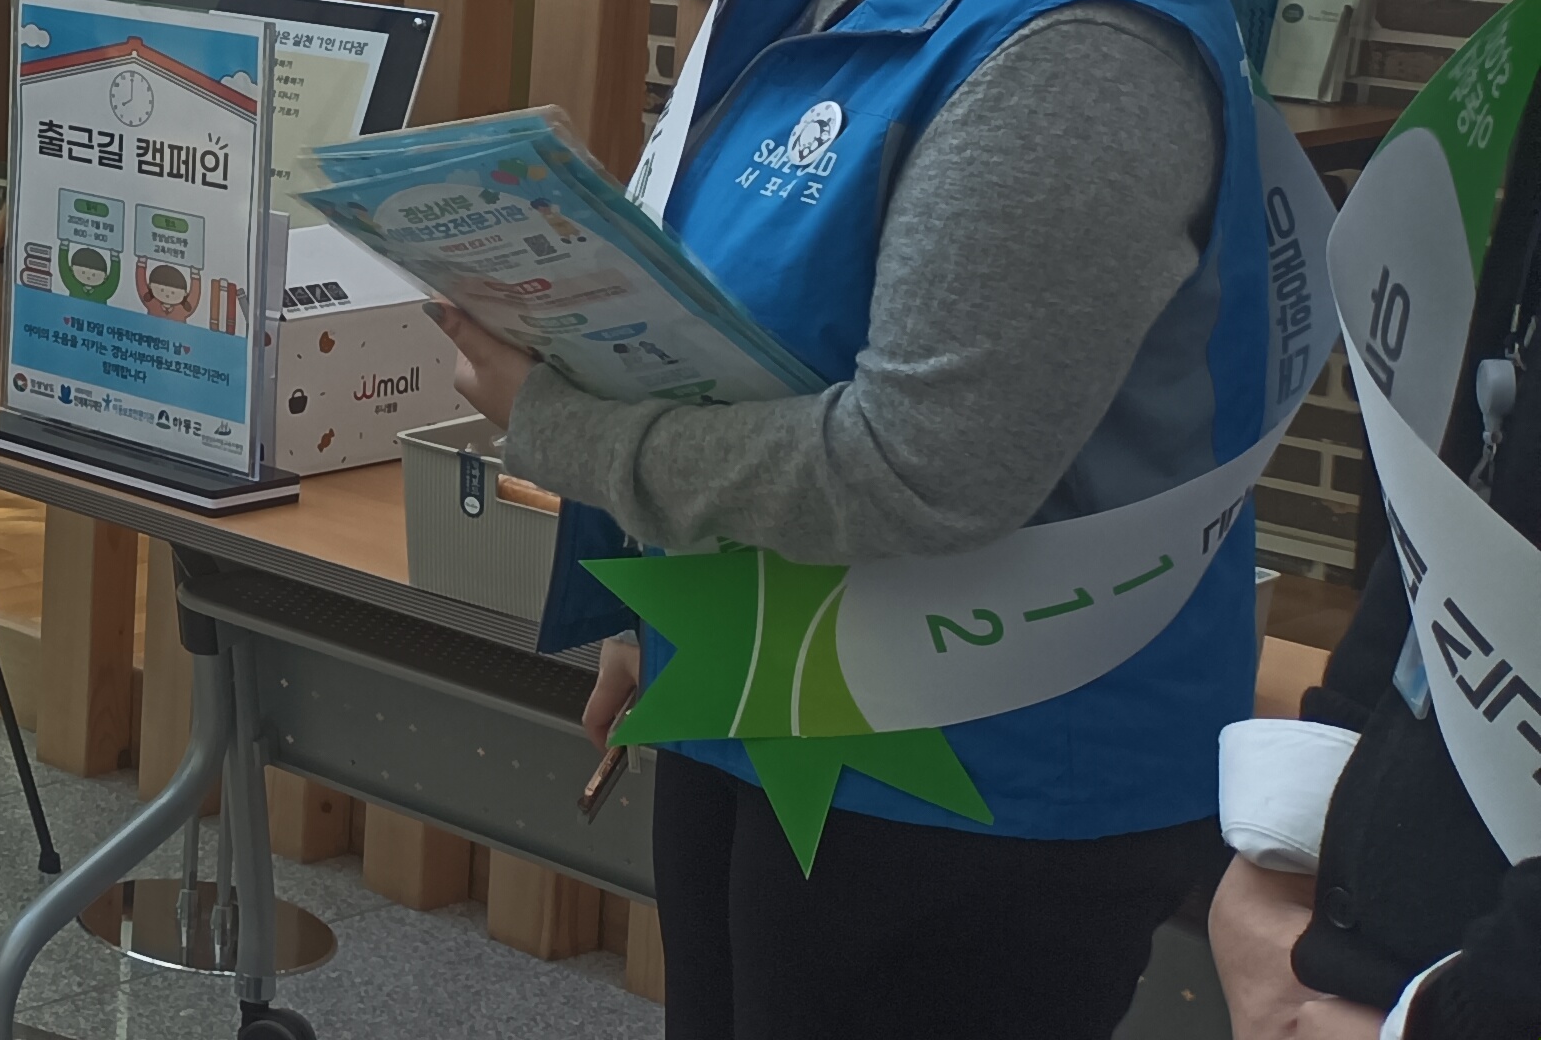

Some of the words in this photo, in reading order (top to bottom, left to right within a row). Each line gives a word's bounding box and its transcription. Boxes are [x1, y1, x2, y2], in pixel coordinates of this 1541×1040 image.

[292, 34, 314, 48] 실천
[37, 120, 124, 170] 출근길
[135, 136, 229, 190] 캠페인
[398, 194, 474, 224] 경남서부
[24, 324, 49, 340] 아이의
[81, 337, 108, 355] 지키는
[172, 340, 182, 354] 날
[172, 416, 202, 437] 하동군
[924, 554, 1175, 654] 112
